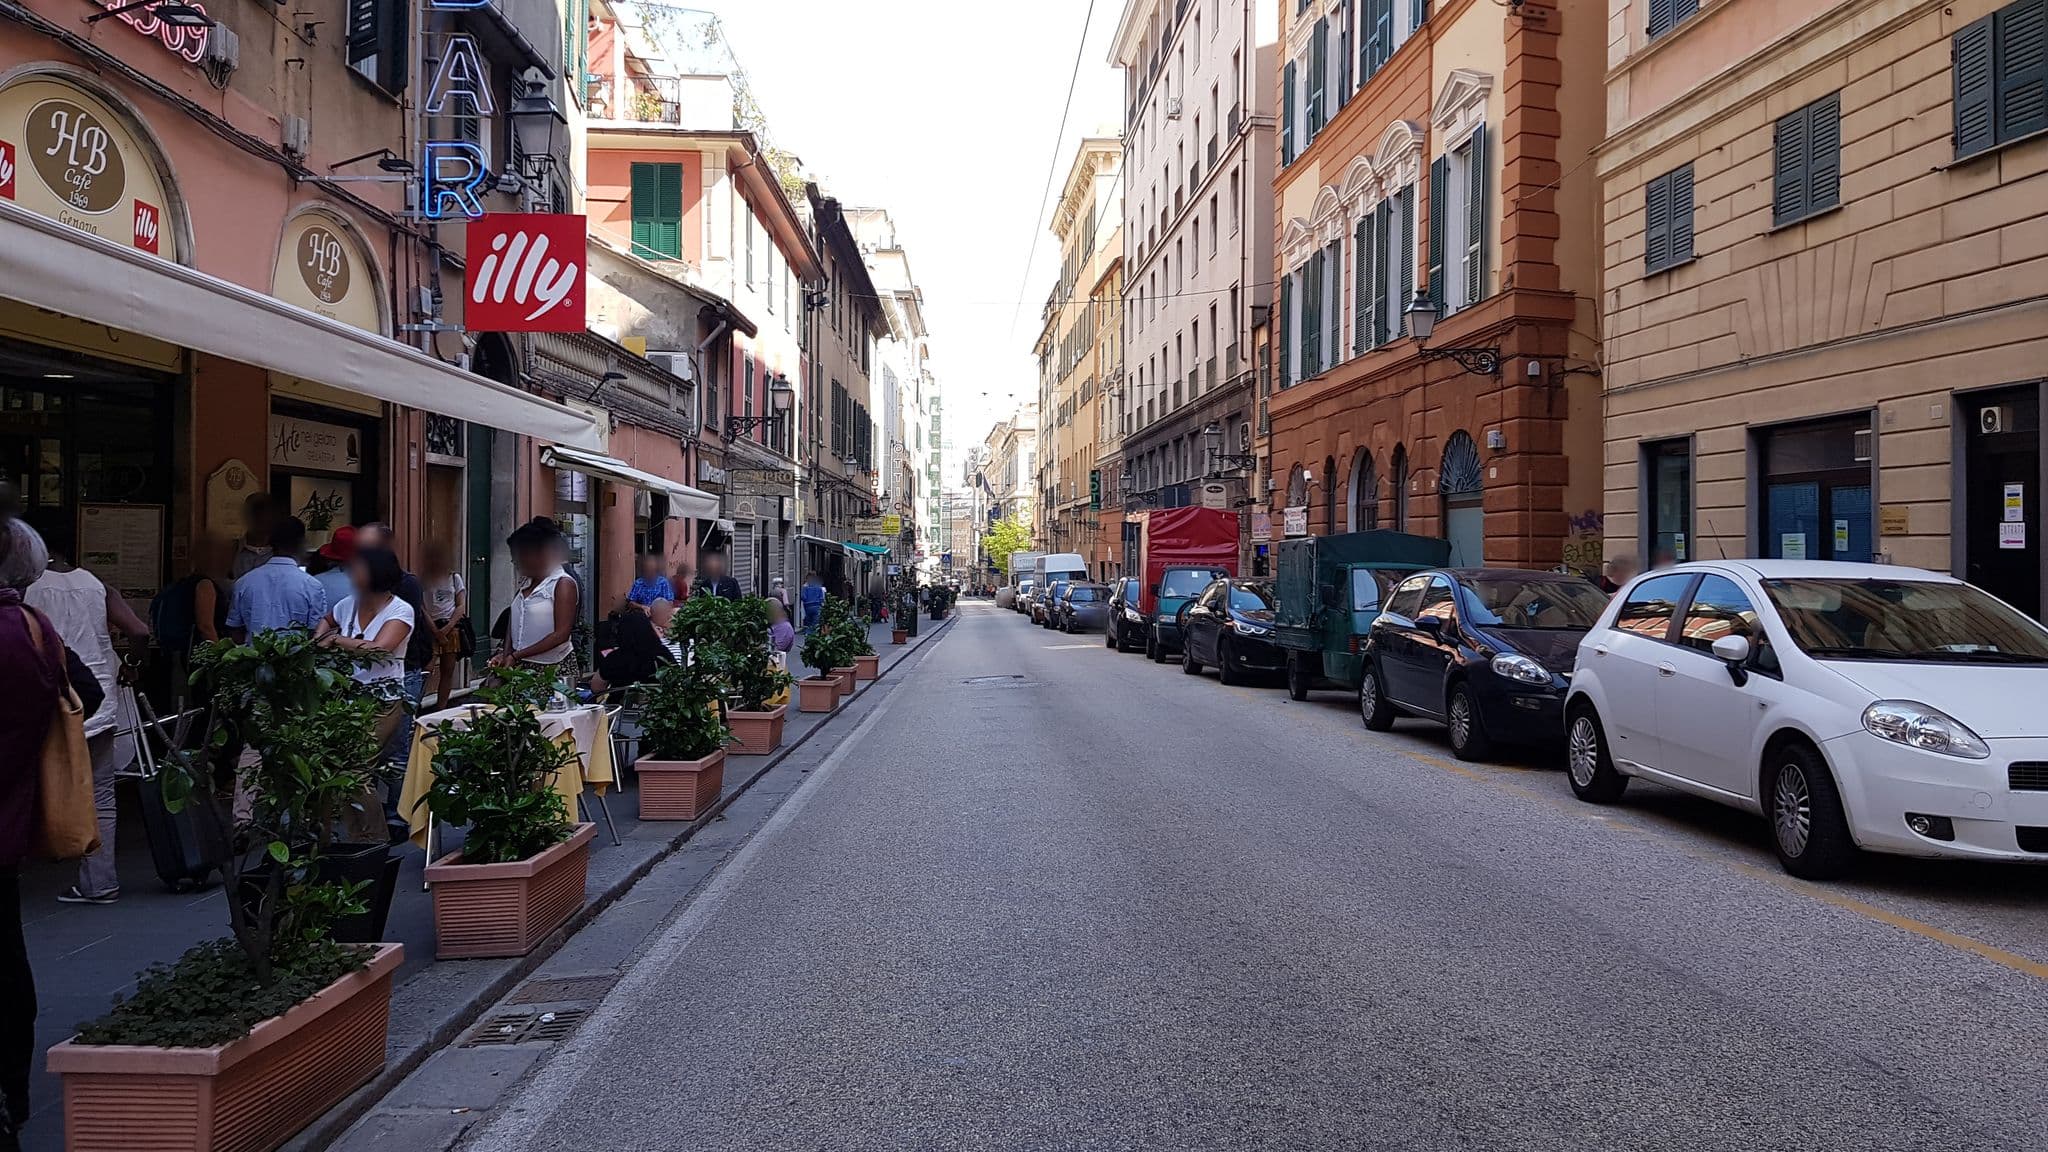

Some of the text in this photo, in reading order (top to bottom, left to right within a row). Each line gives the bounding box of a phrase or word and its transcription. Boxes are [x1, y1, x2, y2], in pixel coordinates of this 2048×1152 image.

[425, 0, 493, 219] AR
[47, 110, 108, 175] HB
[69, 191, 88, 208] 1969
[136, 207, 157, 245] illy
[307, 233, 340, 276] HB
[472, 231, 578, 321] illy
